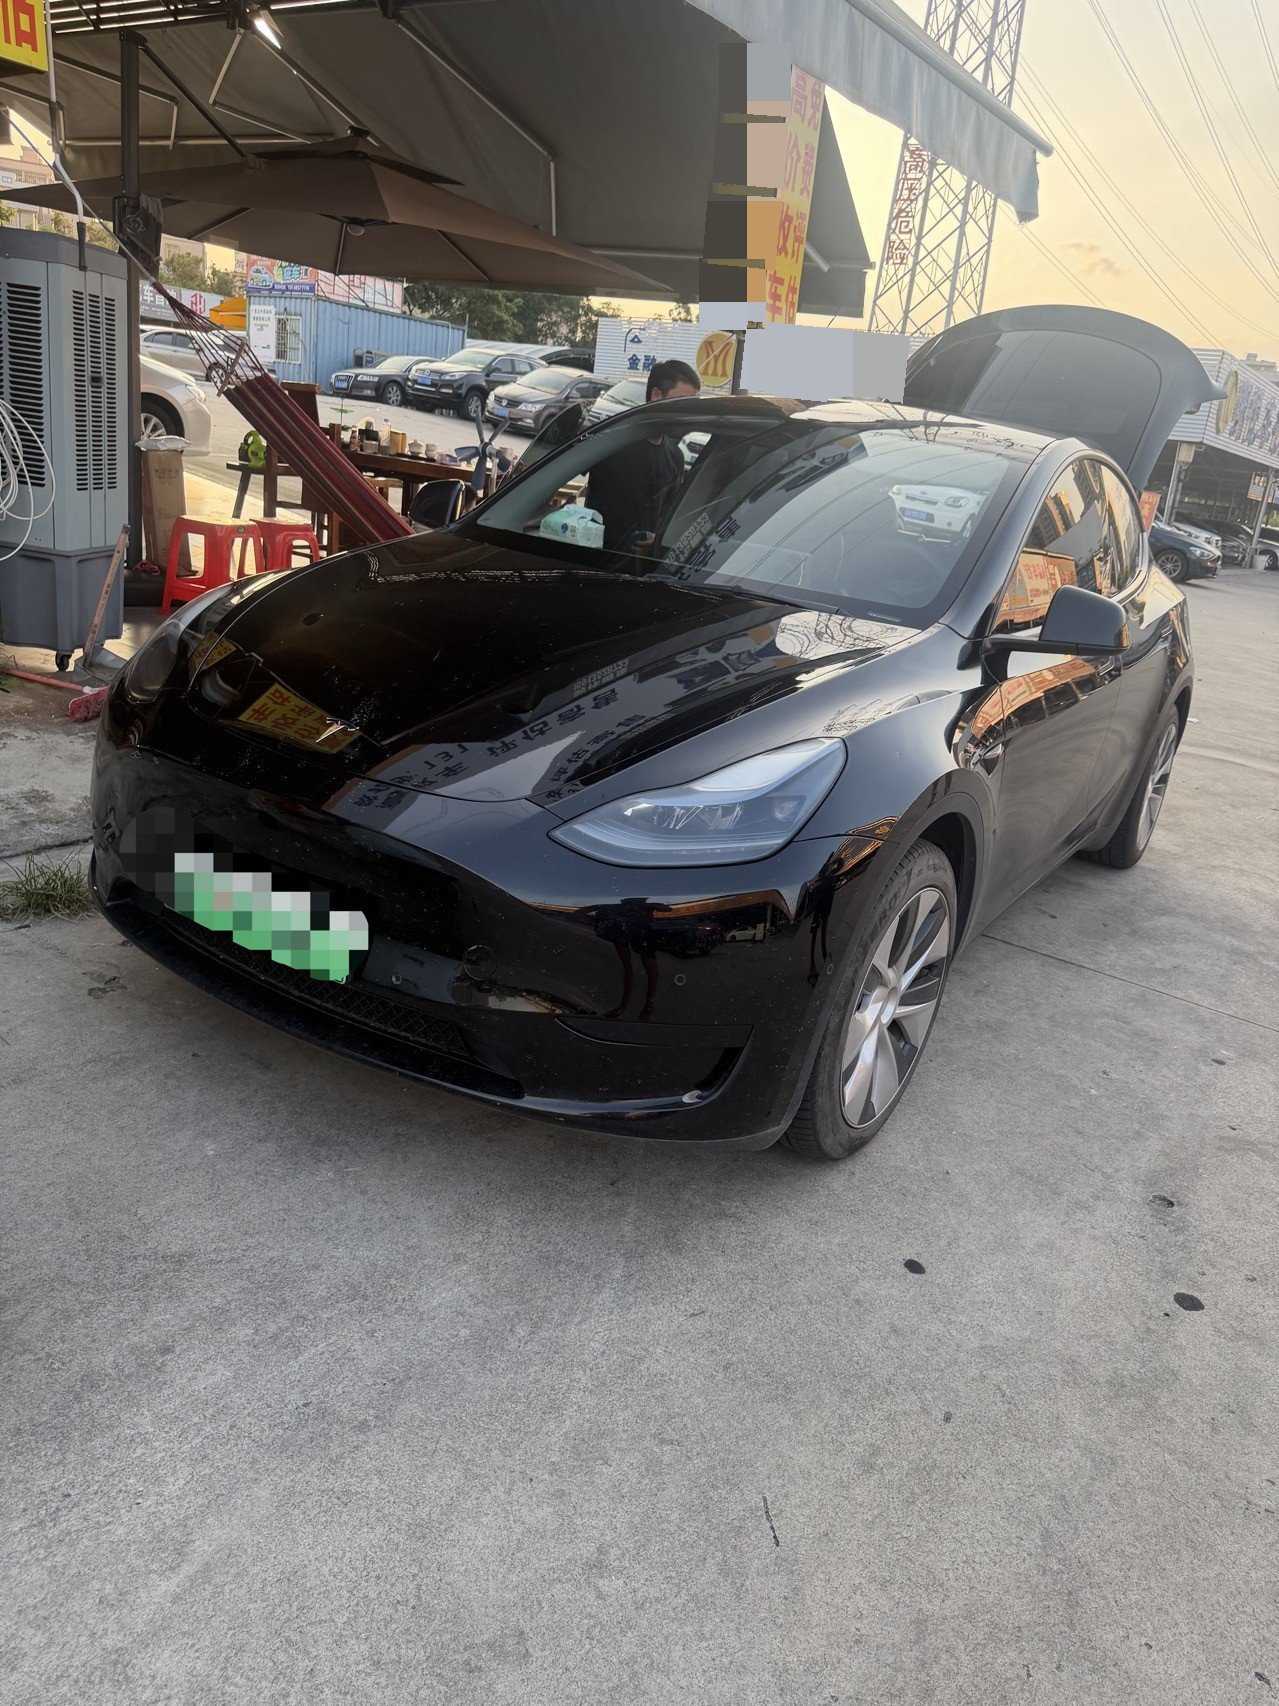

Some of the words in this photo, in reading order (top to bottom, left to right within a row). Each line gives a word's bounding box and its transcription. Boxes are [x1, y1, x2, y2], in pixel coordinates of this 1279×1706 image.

[766, 70, 808, 323] 高价收车
[784, 80, 822, 324] 免费评估
[885, 145, 927, 265] 高压危险
